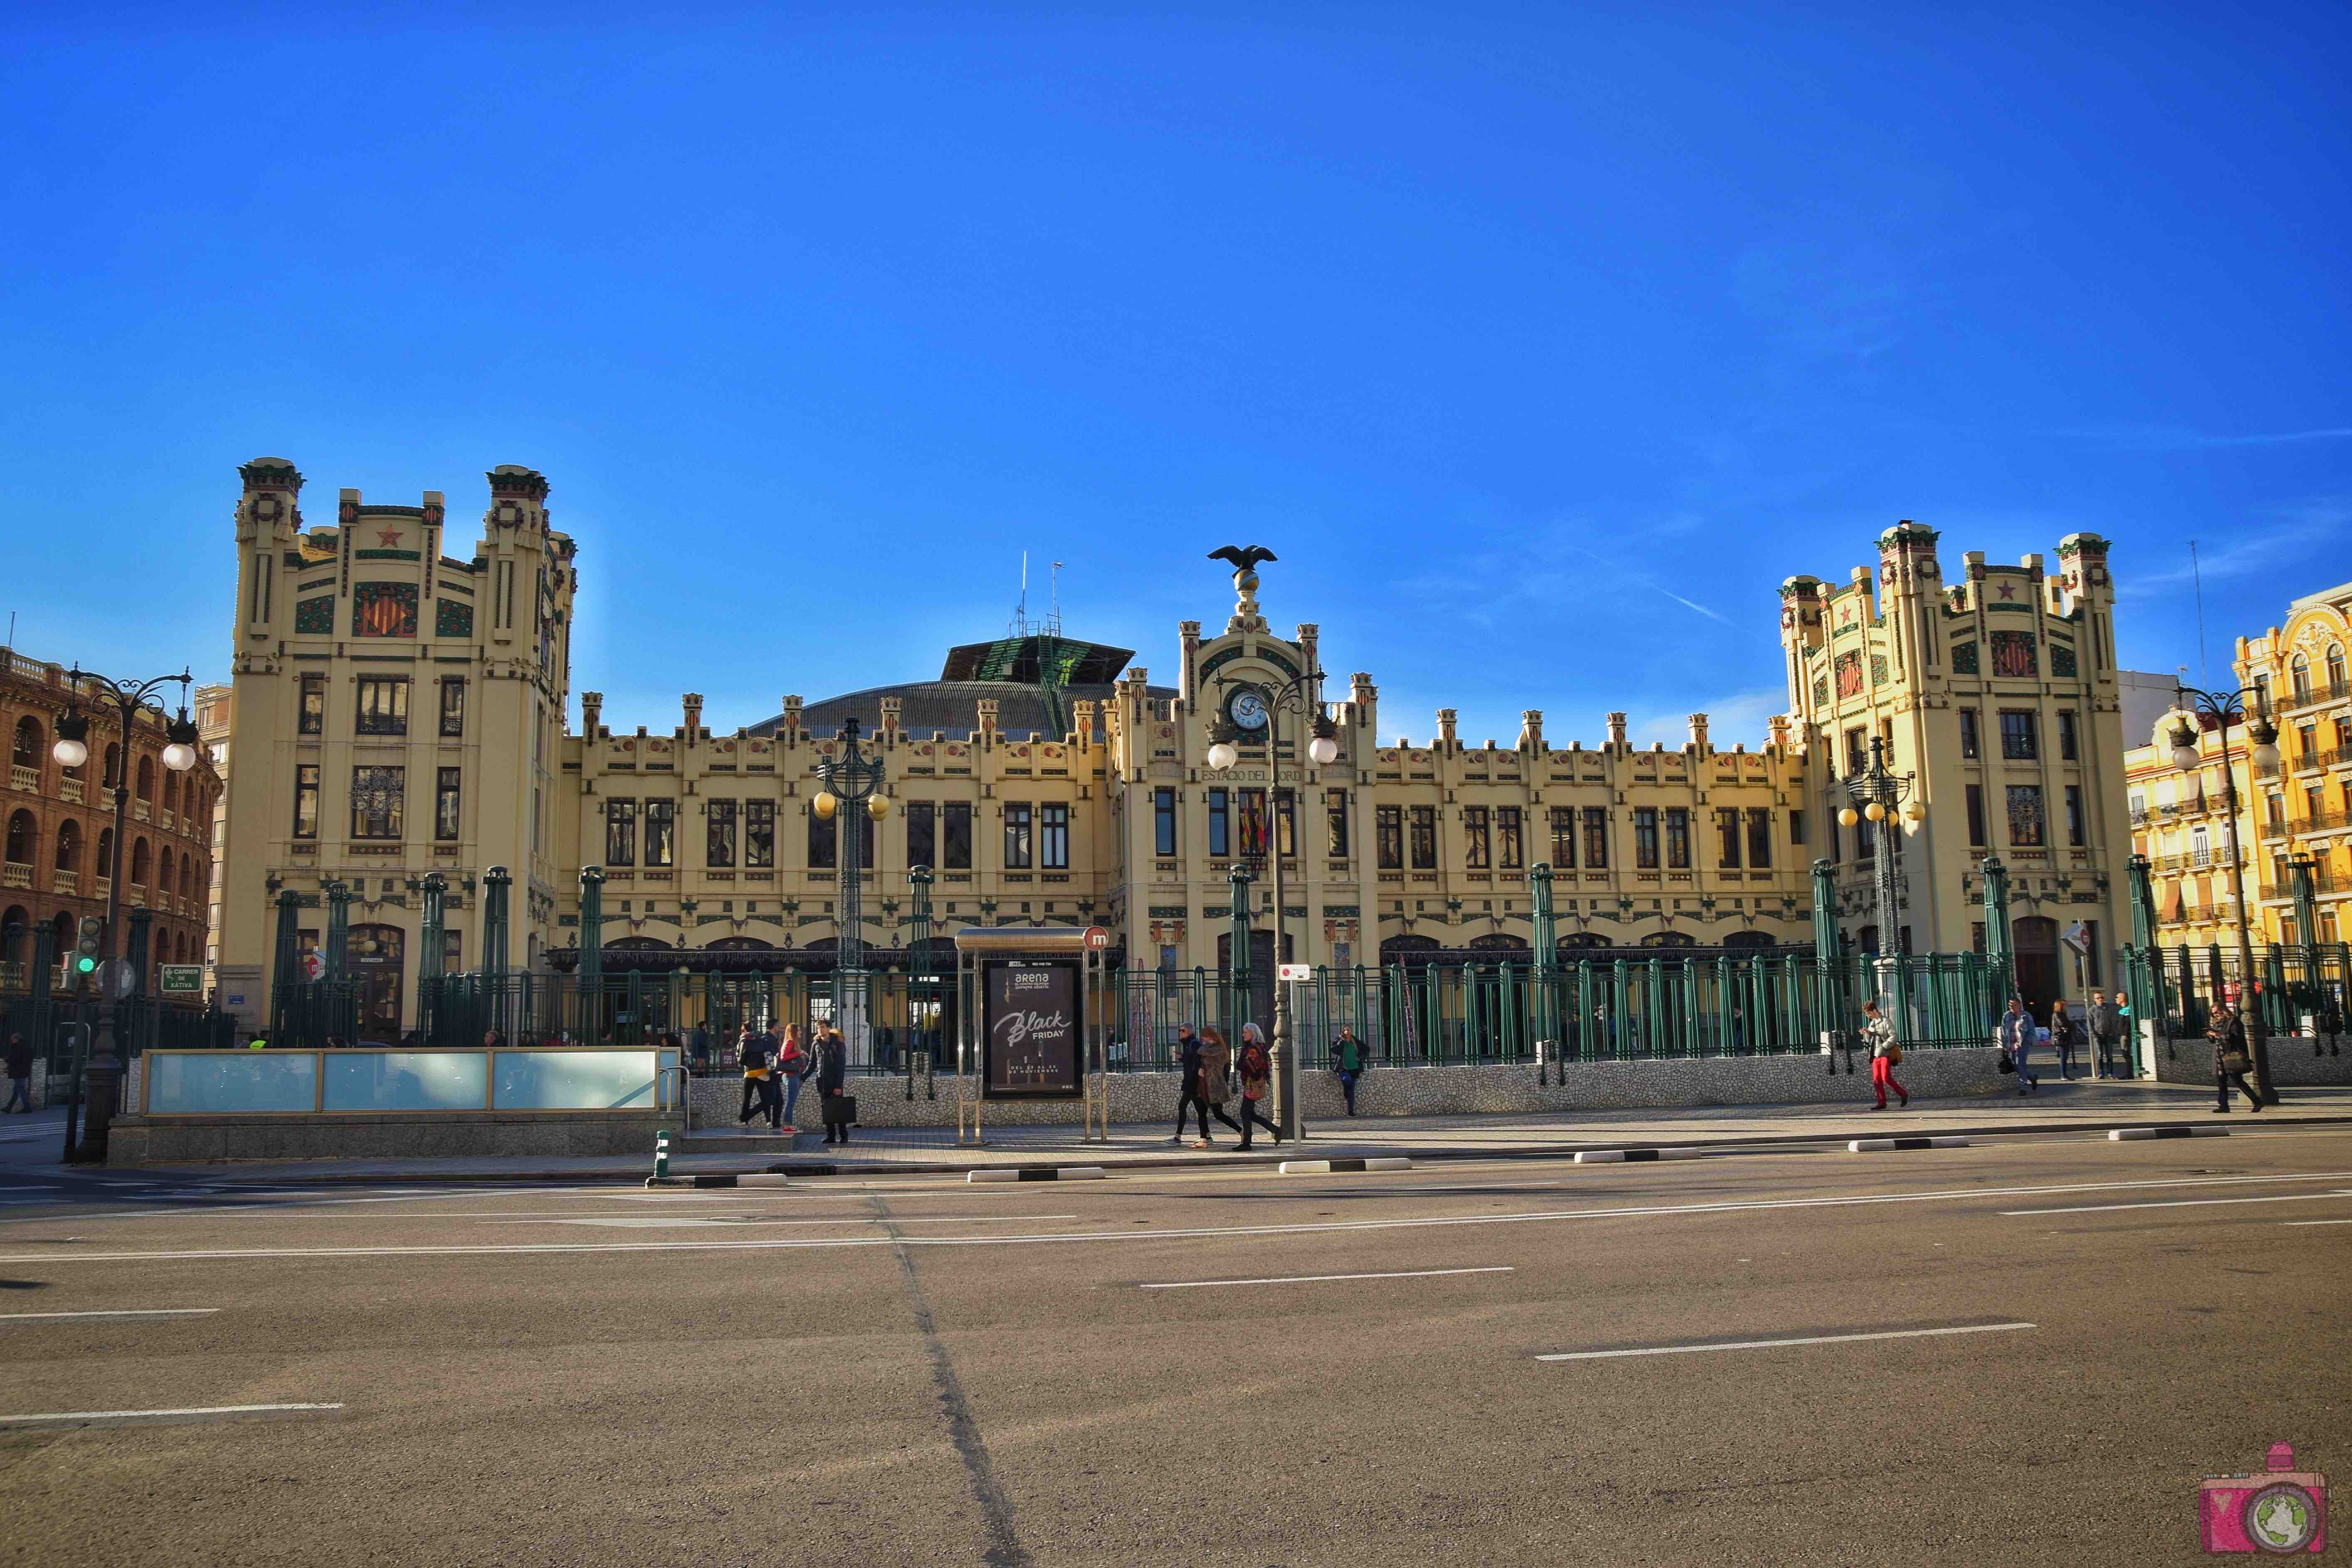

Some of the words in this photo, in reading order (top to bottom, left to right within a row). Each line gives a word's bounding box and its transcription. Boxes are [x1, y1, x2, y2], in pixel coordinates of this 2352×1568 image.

[1248, 771, 1269, 781] DEL
[1278, 771, 1302, 781] ORD
[1093, 935, 1106, 945] m
[994, 1009, 1072, 1047] Black
[1032, 1029, 1064, 1040] FRIDAY
